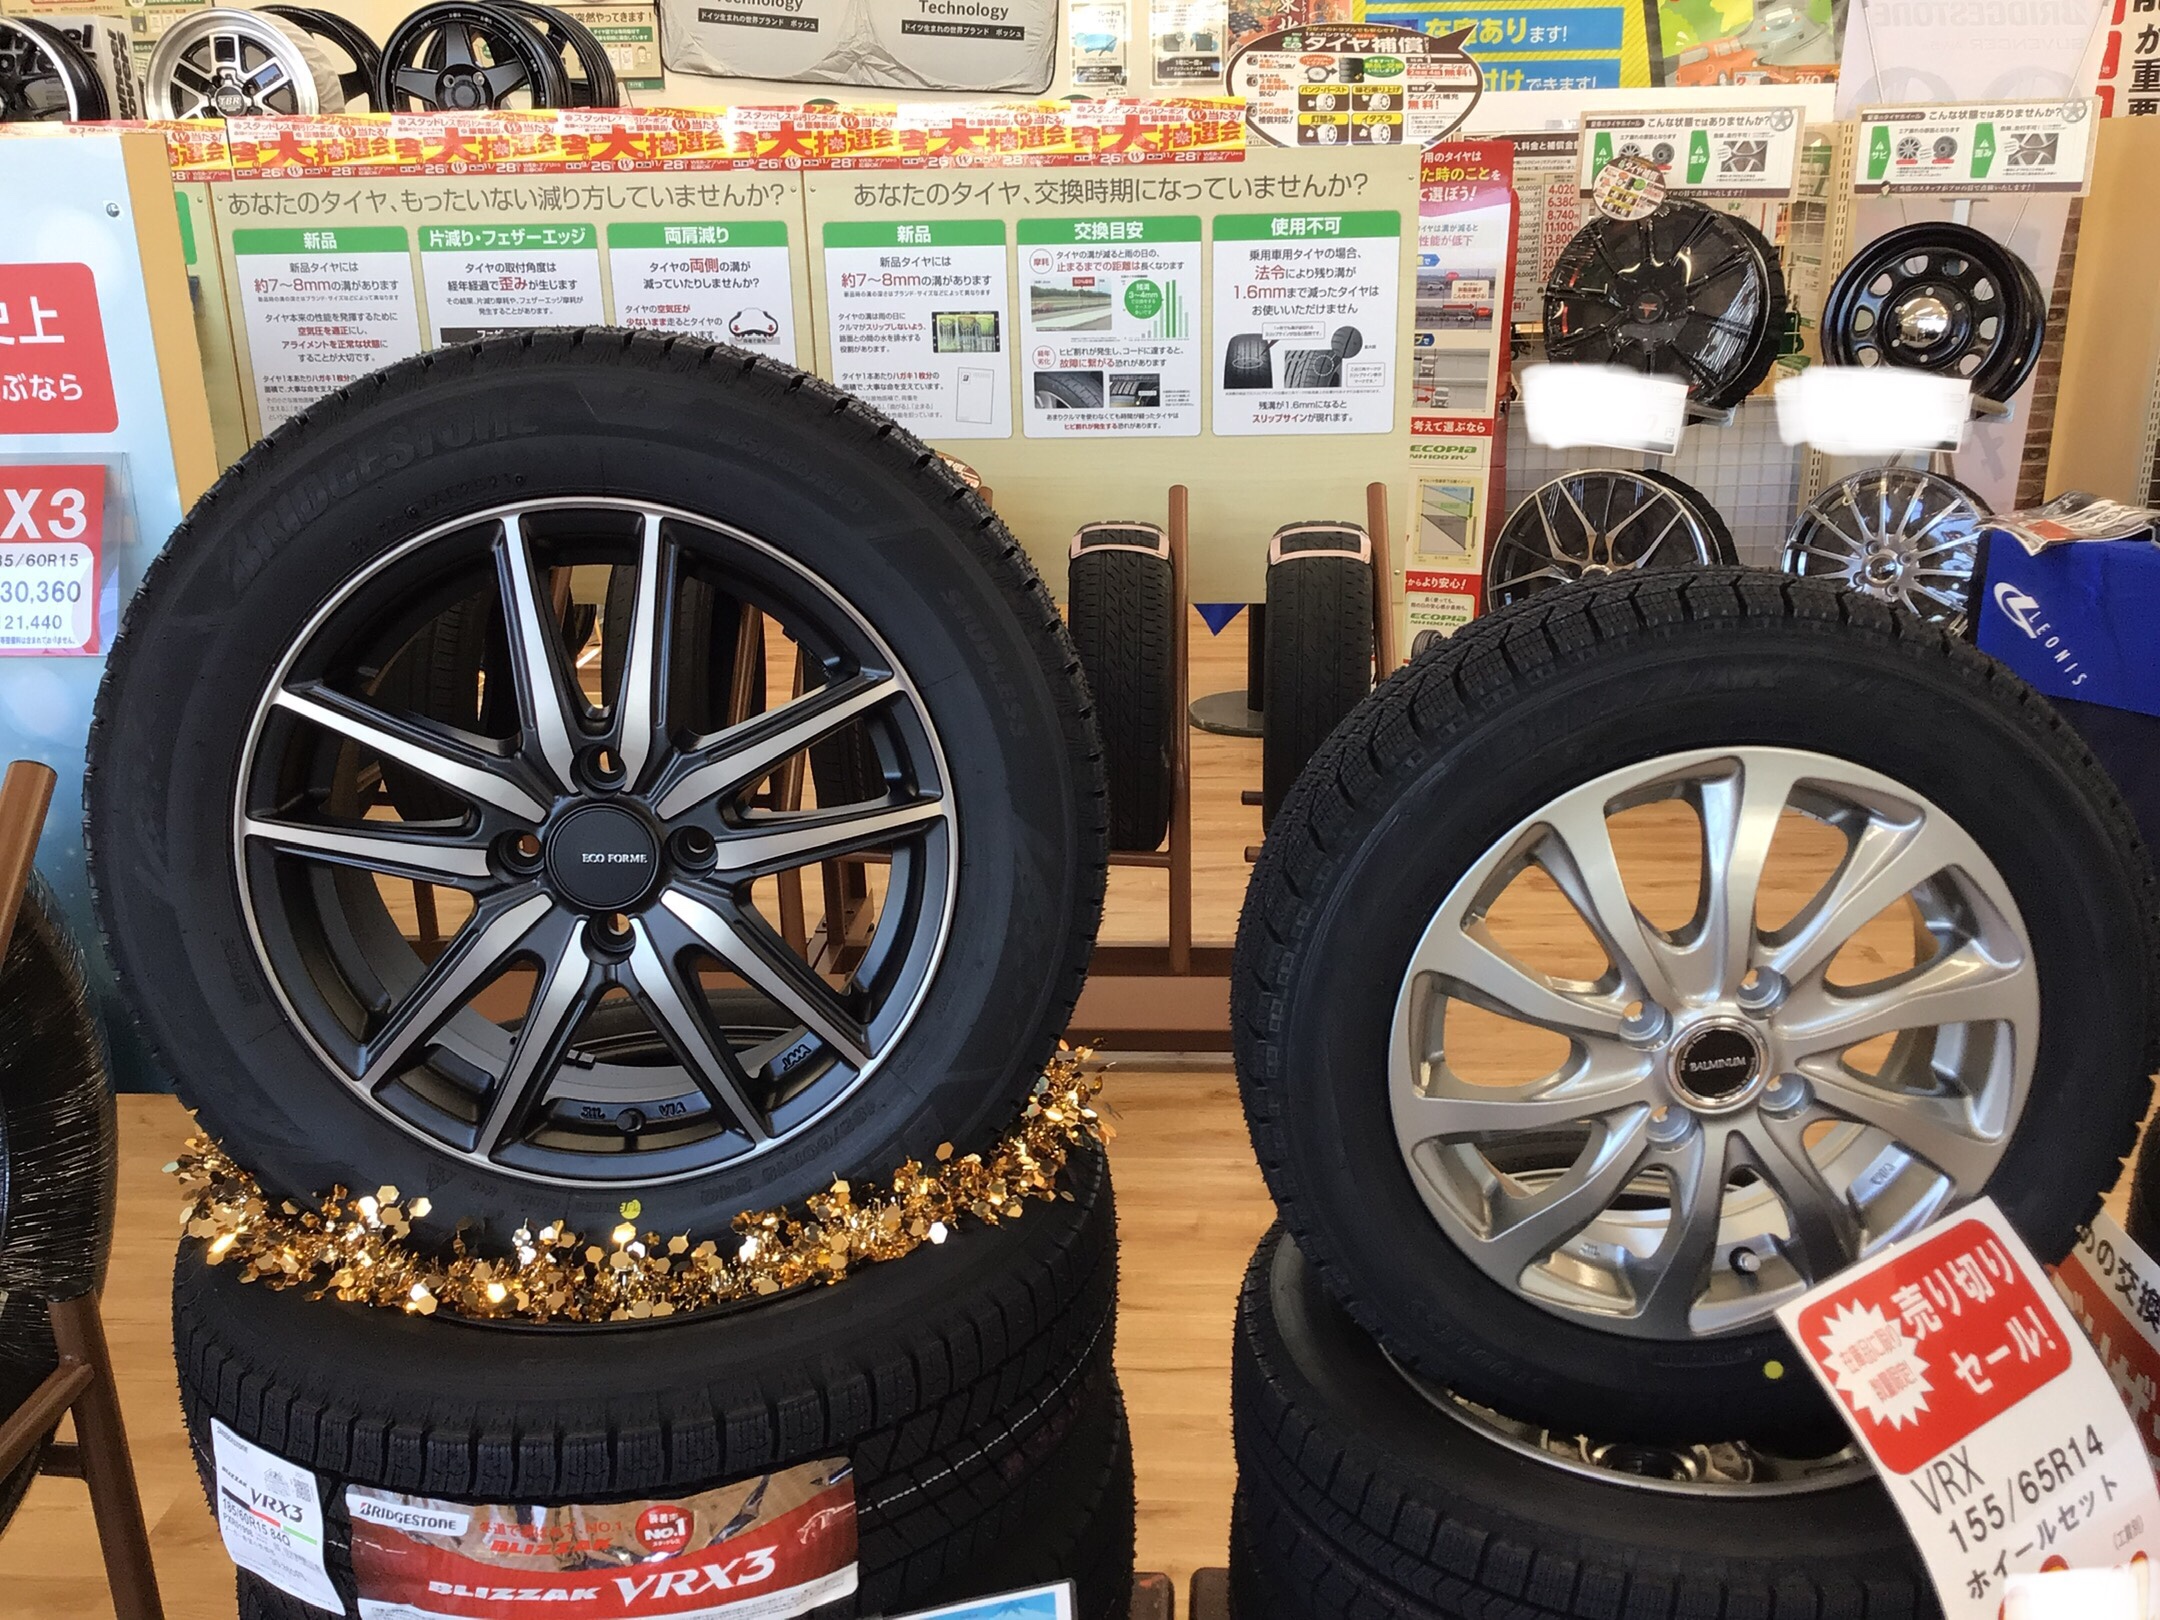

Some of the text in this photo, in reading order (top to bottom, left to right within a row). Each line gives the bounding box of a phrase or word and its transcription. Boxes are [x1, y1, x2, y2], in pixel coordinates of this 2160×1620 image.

[918, 0, 1010, 21] Technology
[701, 11, 816, 31] ドイツ生まれの世界ブランド ボッシュ
[904, 22, 1022, 39] ドイツ生まれの世界ブランド ボッシュ
[1305, 36, 1424, 53] タイヤ補償
[1208, 109, 1241, 121] 当たる!
[1361, 114, 1393, 122] イタズラ
[1929, 107, 2062, 120] こんな状態ではありませんか?
[860, 117, 893, 129] 当たる!
[1648, 115, 1770, 128] こんな状態ではありませんか?
[1689, 156, 1707, 164] 歪み
[1871, 151, 1887, 160] サビ
[1974, 149, 1993, 158] 歪み
[854, 172, 1368, 208] あなたのタイヤ、交換時期になっていませんか?
[228, 183, 784, 216] あなたのタイヤ、もったいない減り方していませんか?
[1074, 221, 1144, 240] 交換目安
[1271, 216, 1342, 236] 使用不可
[303, 232, 337, 249] 新品
[429, 228, 586, 247] 片減り・フェザーエッジ
[664, 226, 730, 245] 両肩減り
[897, 225, 932, 243] 新品
[1419, 235, 1475, 247] 性能が低下
[1056, 249, 1160, 260] タイヤの溝が減ると雨の日の、
[1249, 247, 1362, 261] 乗用車用タイヤの場合、
[289, 262, 359, 273] 新品タイヤには
[465, 262, 557, 274] タイヤの取付角度は
[649, 258, 751, 273] タイヤの両側の溝が
[880, 256, 951, 268] 新品タイヤには
[1033, 258, 1049, 266] 摩耗
[1056, 261, 1185, 273] 止まるまでの距離は長くなります
[1255, 264, 1356, 280] 法令により残り溝が
[448, 276, 578, 292] 経年経過で歪みが生じます
[643, 278, 760, 290] 減っていたりしませんか?
[1233, 285, 1379, 300] 1.6mmまで減ったタイヤは
[479, 308, 553, 316] 発生することがあります。
[625, 304, 691, 314] タイヤの空気圧が
[1252, 303, 1358, 316] お使いいただけません
[265, 312, 399, 323] タイヤ本来の性能を発揮するために
[626, 317, 722, 327] 少ないまま走るとタイヤの
[838, 312, 906, 321] タイヤの溝は雨の日に
[298, 326, 368, 337] 空気圧を適正にし、
[839, 323, 926, 331] クルマがスリップしないよう、
[839, 333, 921, 342] 路面との間の水を排水する
[281, 339, 388, 350] アライメントを正常な状態に
[840, 345, 890, 353] 役割があります。
[298, 353, 376, 363] することが大切です。
[1059, 346, 1184, 357] ヒビ割れが発生し、コードに達すると、
[1059, 358, 1167, 368] 故障に繋がる恐れがあります
[842, 372, 940, 381] タイヤ1本あたりハガキ1枚分の
[1258, 400, 1347, 410] 残溝が1.6mmになると
[1046, 412, 1179, 421] あまりクルマを使わなくても時間が経ったタイヤは
[1252, 413, 1354, 424] スリップサインが現れます。
[1064, 422, 1162, 431] ヒビ割れが発生する恐れがあります。
[1, 488, 88, 540] X3
[1, 580, 82, 604] 30,360
[4, 615, 63, 630] 21,440
[2029, 610, 2088, 686] LEONIS
[582, 853, 648, 864] ECO FORME
[1689, 1056, 1747, 1073] BALMINUM
[1890, 1238, 2016, 1341] 売り切り
[1950, 1305, 2057, 1395] セール!
[1911, 1446, 1985, 1516] VRX
[1949, 1424, 2105, 1553] 155/65R14
[250, 1487, 304, 1524] VRX3
[360, 1501, 457, 1530] BRIDGESTONE
[644, 1518, 686, 1541] NO.1
[1966, 1474, 2119, 1601] ホイールセット
[490, 1538, 613, 1556] BLIZZAK
[428, 1580, 602, 1602] BLIZZAK
[611, 1545, 780, 1608] VRX3
